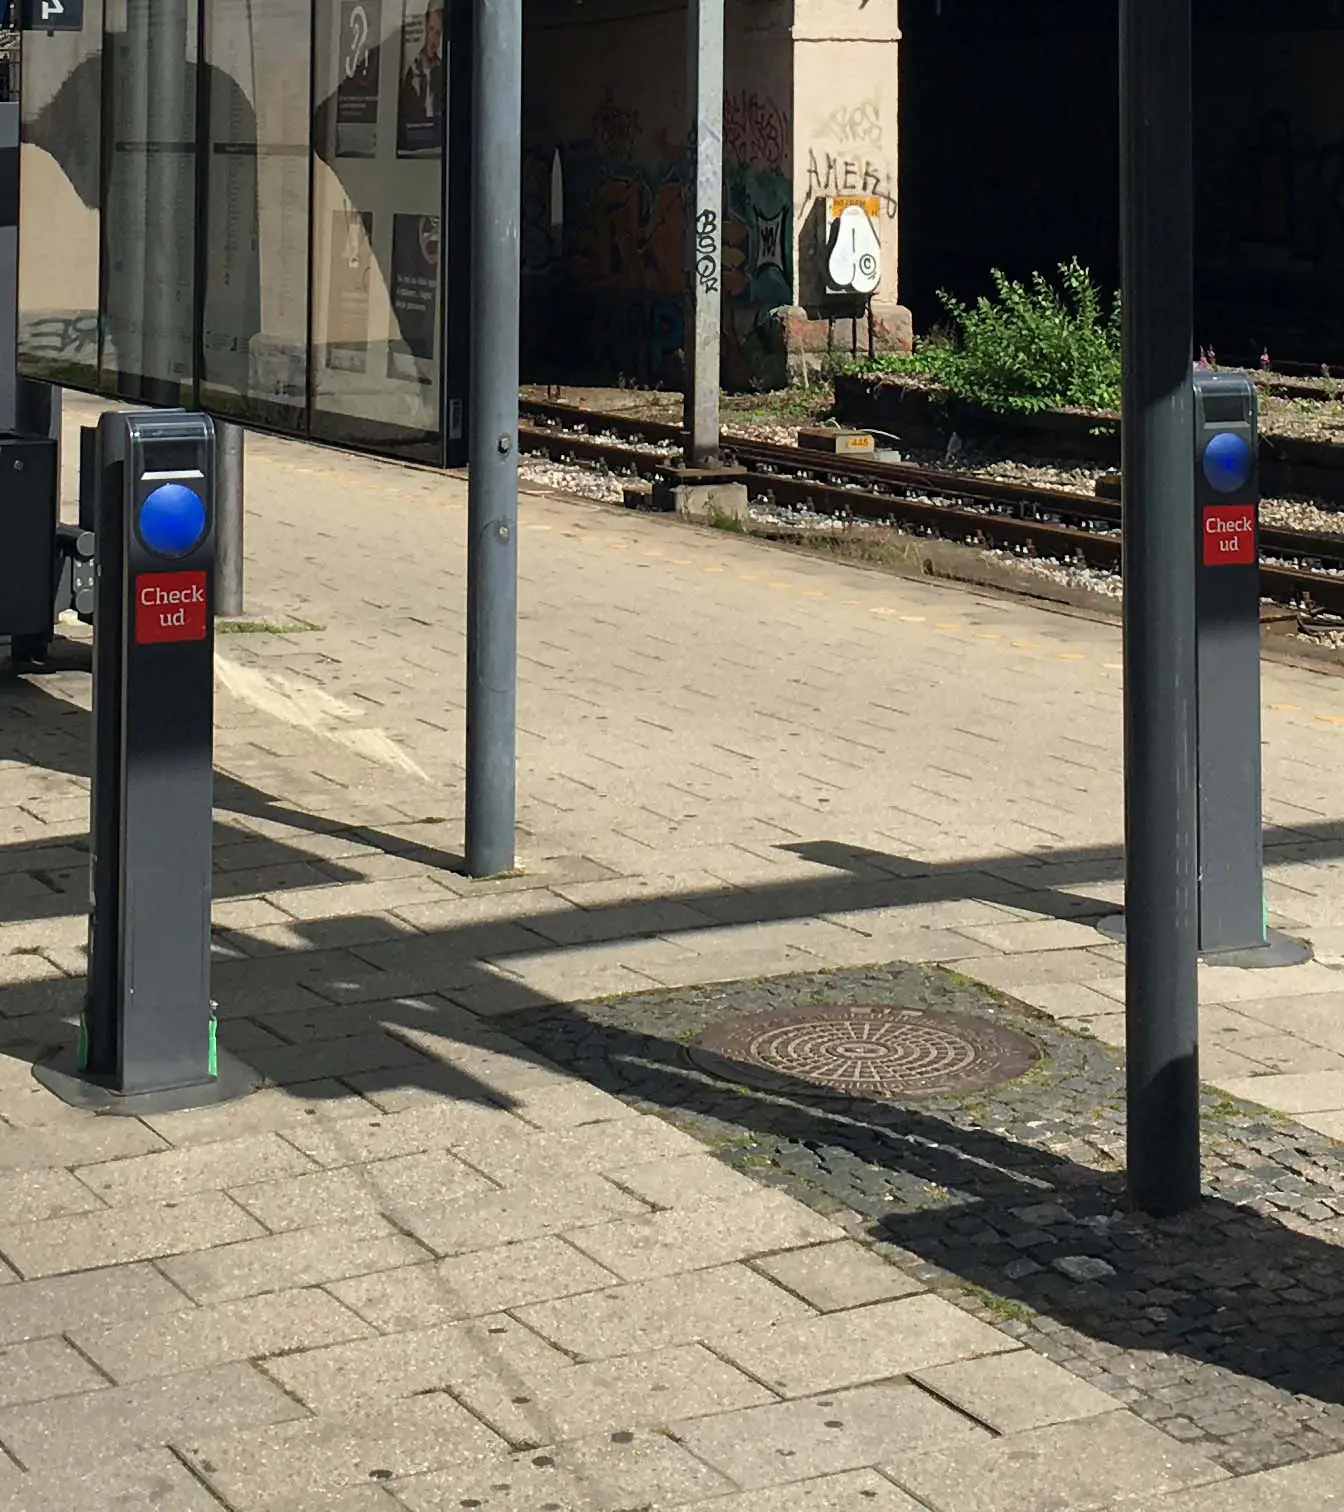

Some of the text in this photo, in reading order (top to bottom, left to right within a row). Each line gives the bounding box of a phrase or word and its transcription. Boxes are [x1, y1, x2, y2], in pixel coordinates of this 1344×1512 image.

[1206, 516, 1252, 534] Check
[1220, 537, 1239, 552] ud
[141, 585, 205, 607] Check
[160, 609, 186, 627] ud
